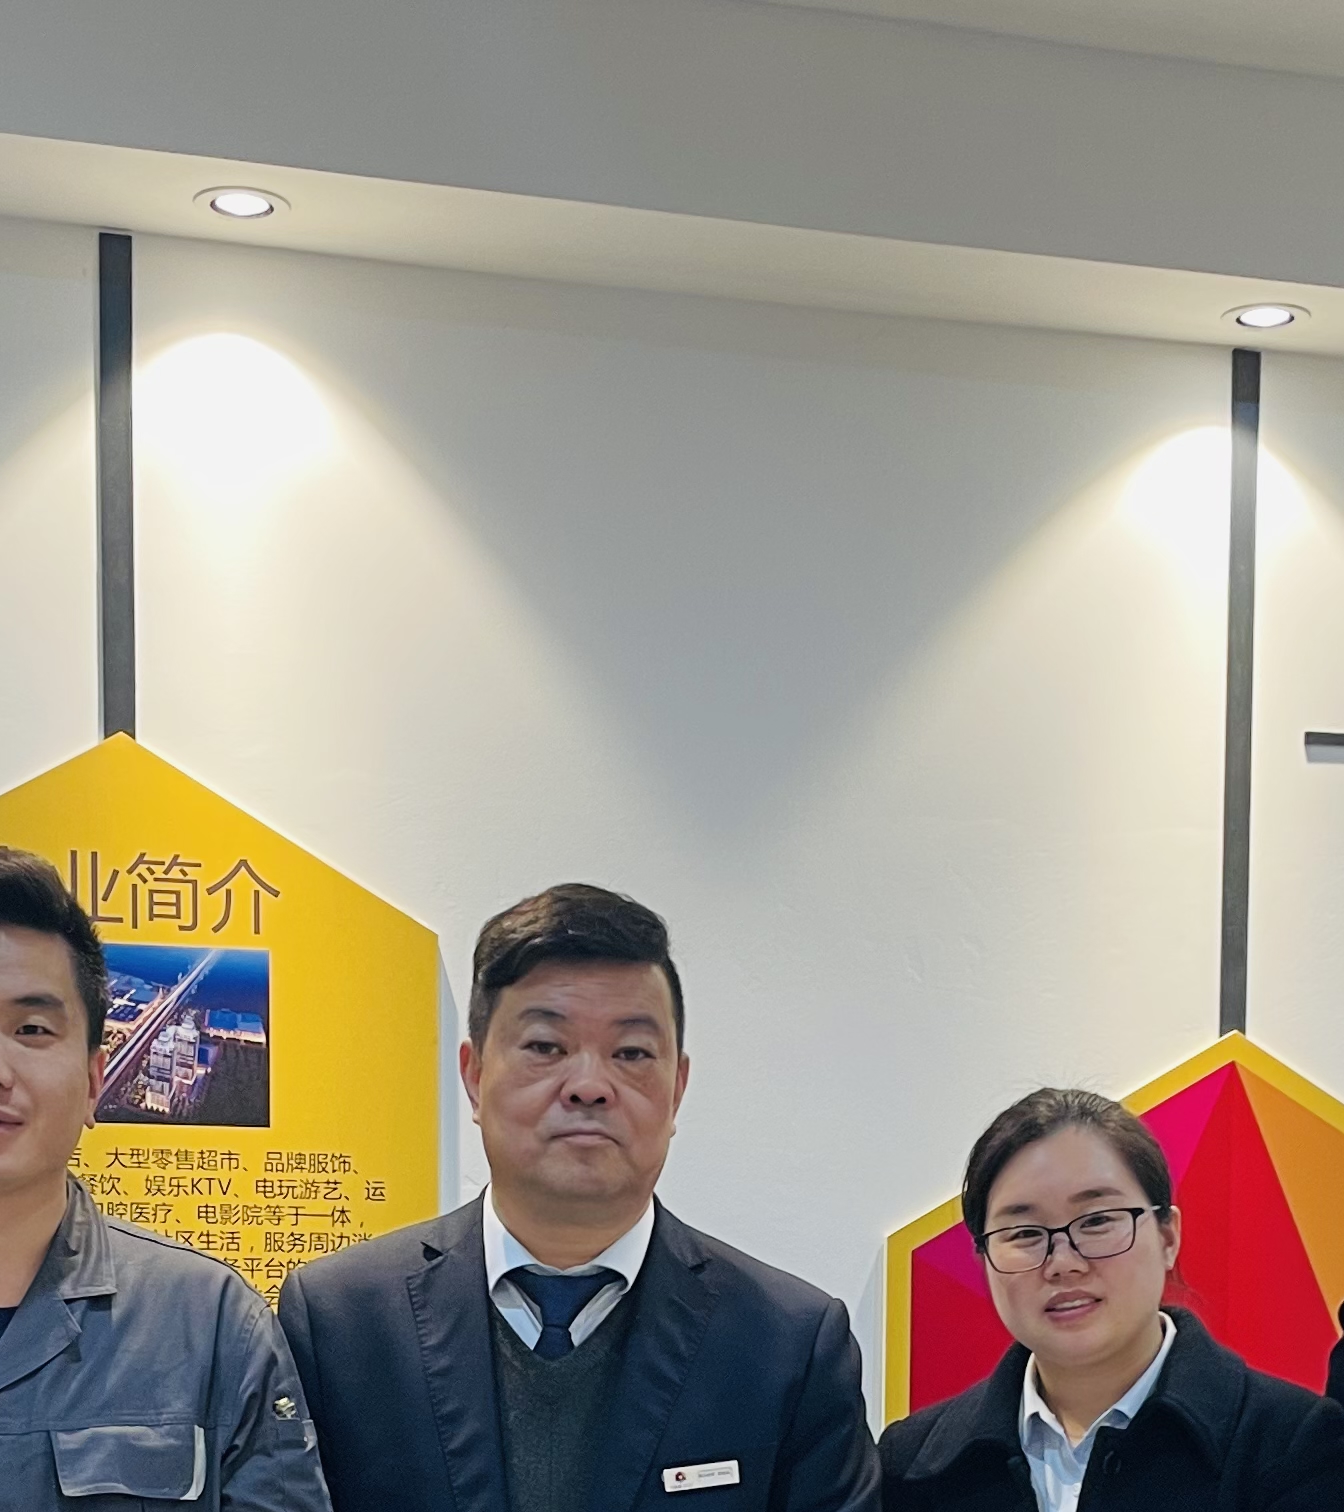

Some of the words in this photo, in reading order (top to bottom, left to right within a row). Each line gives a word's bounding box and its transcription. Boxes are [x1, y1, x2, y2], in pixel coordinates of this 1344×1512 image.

[68, 849, 282, 936] 业简介
[154, 1230, 373, 1254] 区生活，服务周边
